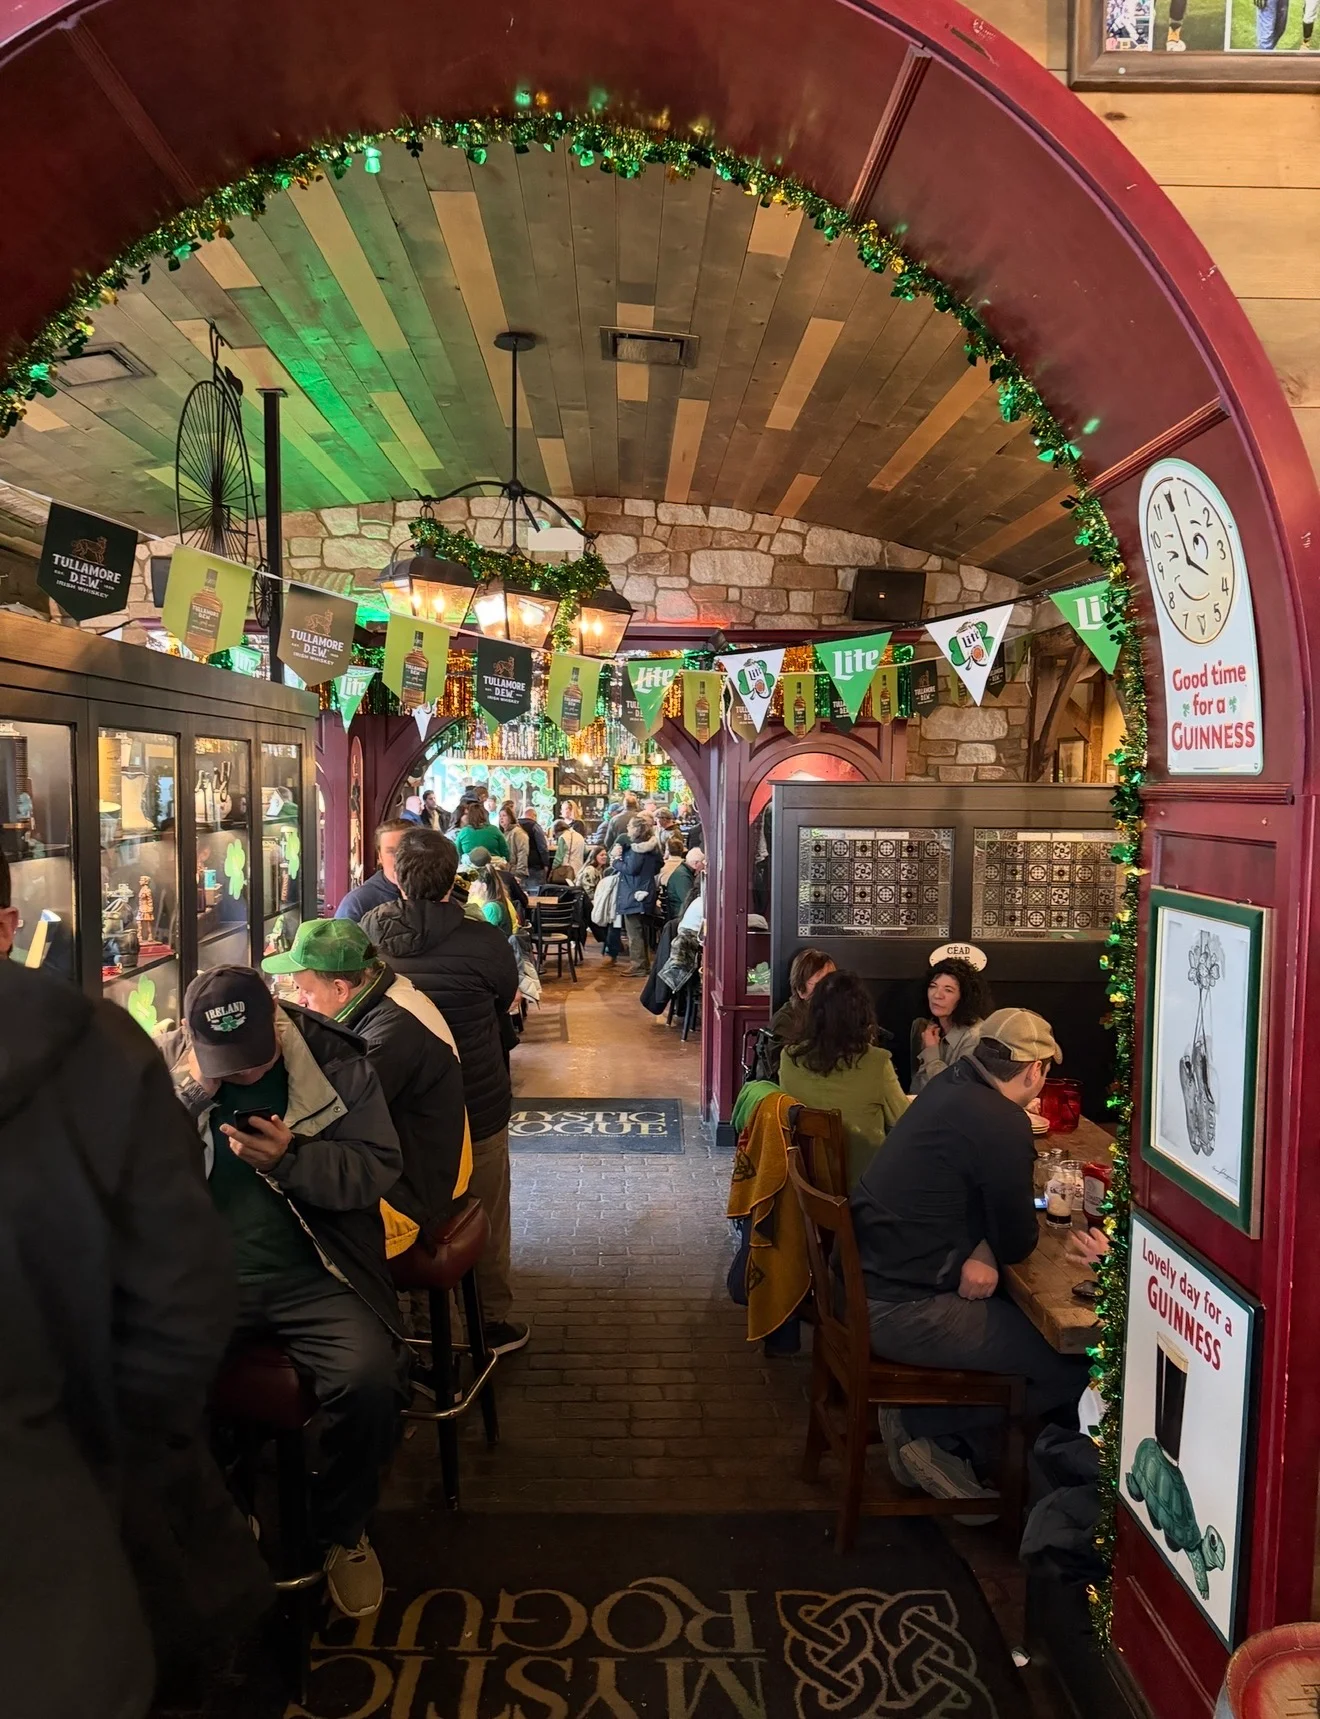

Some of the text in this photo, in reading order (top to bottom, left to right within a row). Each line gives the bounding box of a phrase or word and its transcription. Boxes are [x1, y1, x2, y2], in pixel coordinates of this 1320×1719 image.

[1153, 504, 1163, 521] 11
[1202, 507, 1213, 528] 2
[1150, 531, 1162, 549] 10
[1216, 540, 1226, 560] 3
[52, 553, 121, 584] TULLAMORE
[1157, 562, 1165, 580] 9
[56, 579, 109, 599] IRISH WHISKEY
[1221, 577, 1229, 596] 4
[1168, 591, 1176, 610] 8
[1073, 595, 1109, 630] Li
[1182, 611, 1190, 630] 7
[1213, 603, 1222, 622] 5
[289, 628, 345, 652] TULLAMORE
[832, 648, 879, 681] Lite
[338, 674, 367, 698] Lite
[483, 675, 526, 692] TULLAMORE
[635, 667, 674, 694] Lite
[1172, 660, 1247, 692] Good time
[1193, 692, 1226, 716] for a
[1171, 721, 1256, 751] GUINNESS
[204, 1001, 246, 1022] IRELAND
[1142, 1237, 1233, 1338] Lovely day for a
[1147, 1274, 1222, 1372] GUINNESS
